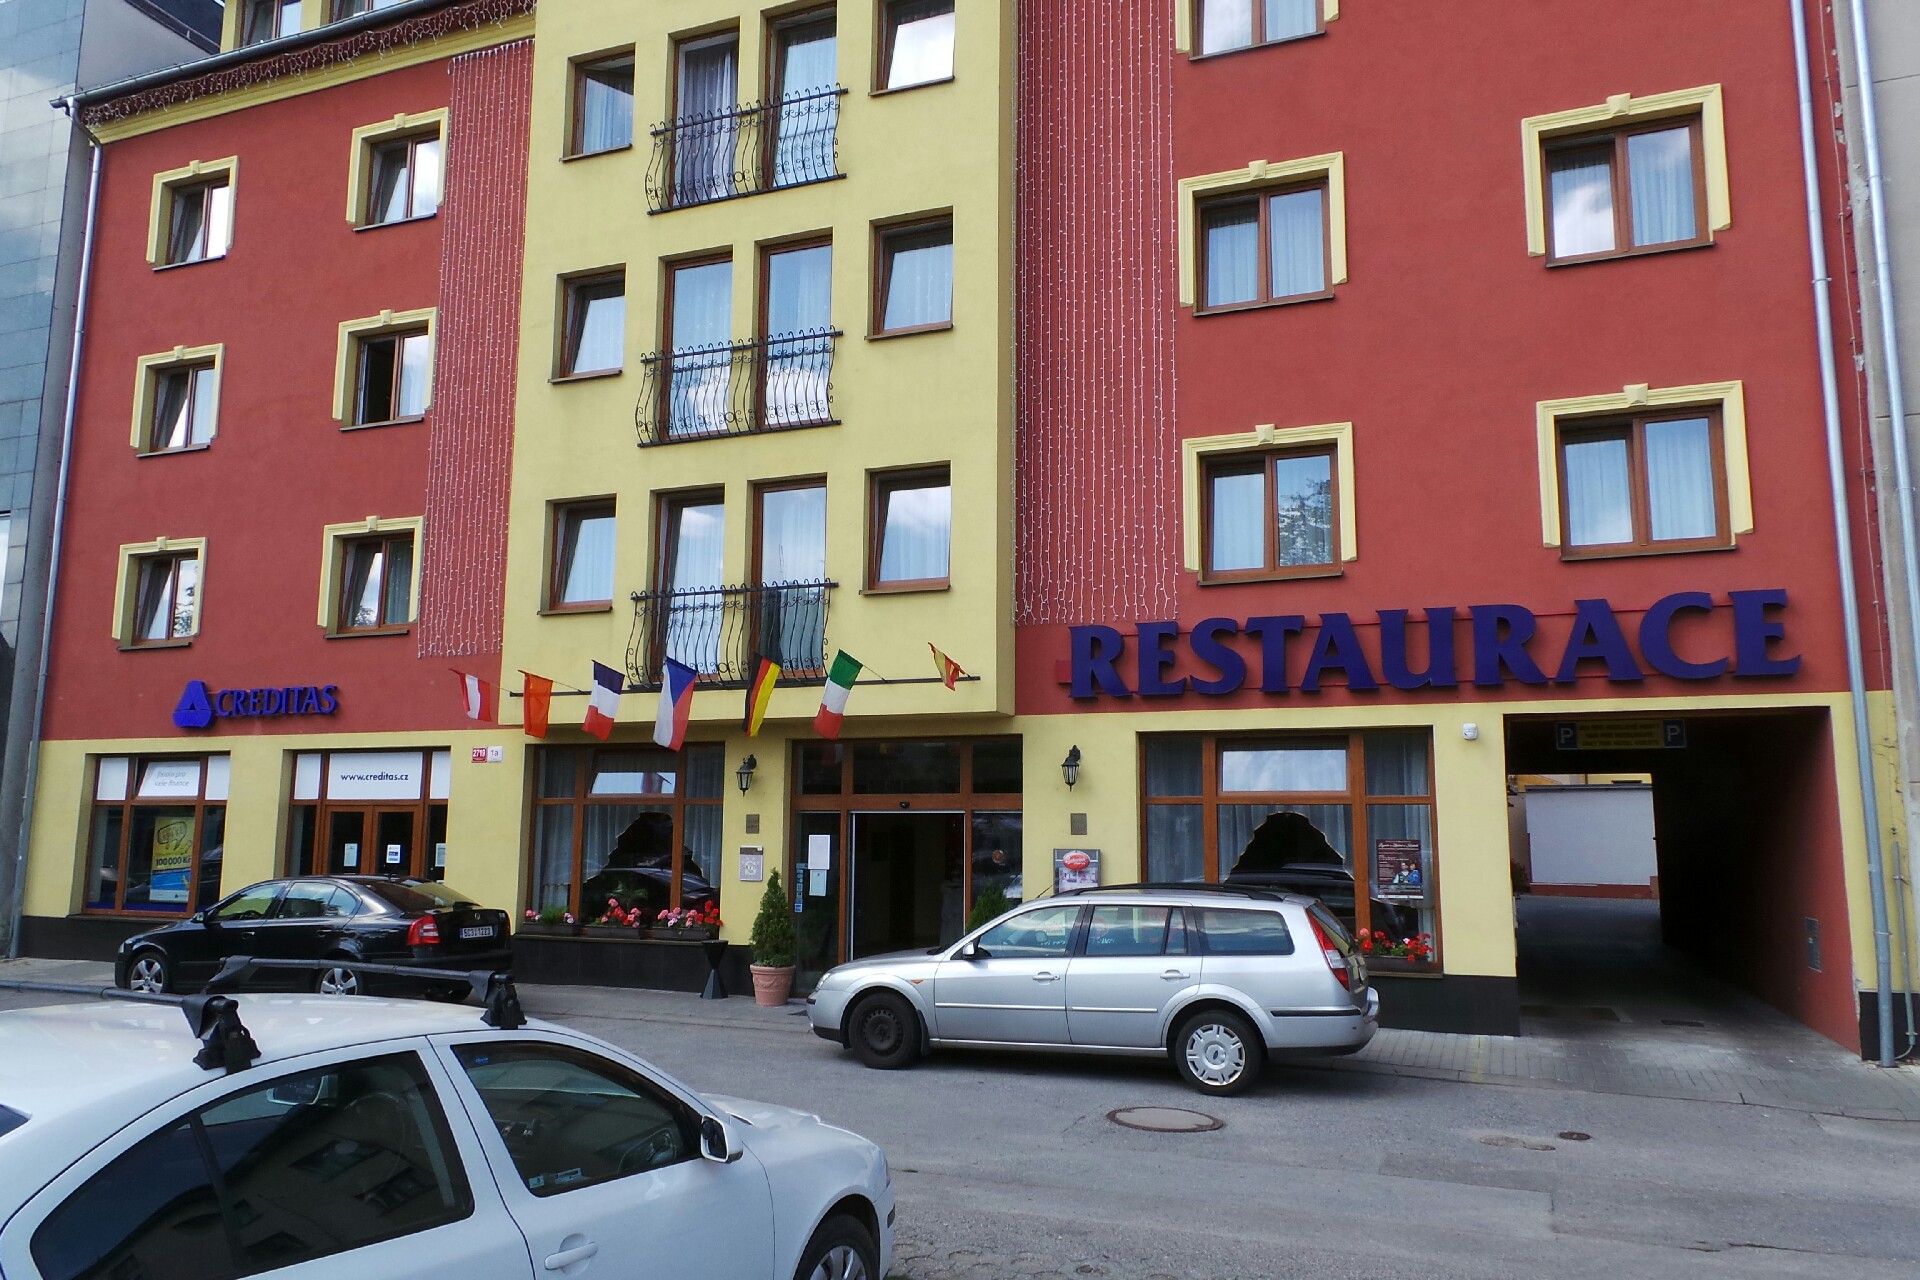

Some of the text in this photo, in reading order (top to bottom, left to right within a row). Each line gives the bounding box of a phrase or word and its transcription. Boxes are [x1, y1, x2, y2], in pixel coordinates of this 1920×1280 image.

[1068, 588, 1802, 699] RESTAURACE
[215, 685, 338, 717] CREDITAS
[1560, 727, 1574, 744] P
[1666, 724, 1681, 742] P
[340, 771, 409, 781] www.creditas.cz
